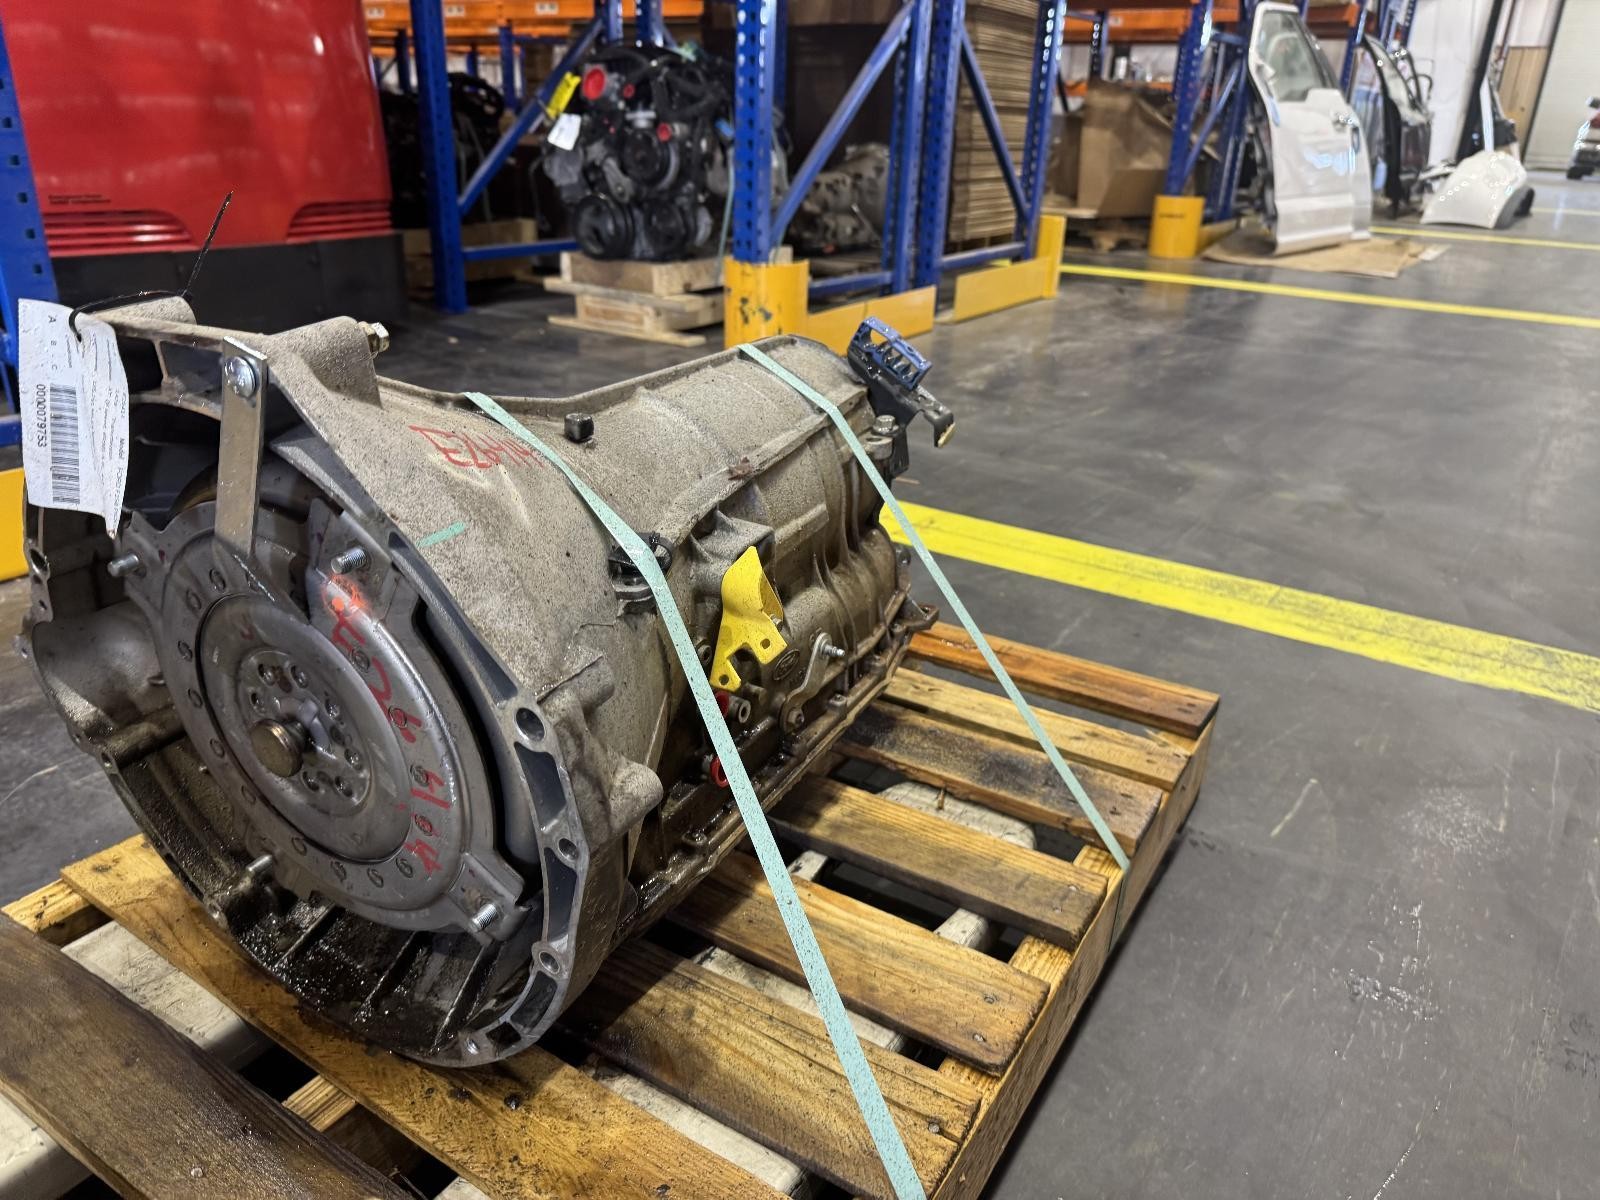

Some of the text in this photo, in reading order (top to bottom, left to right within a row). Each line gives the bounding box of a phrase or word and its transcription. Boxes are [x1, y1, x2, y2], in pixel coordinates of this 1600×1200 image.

[47, 315, 57, 323] A
[36, 384, 47, 448] 0000079753
[118, 437, 126, 460] Model
